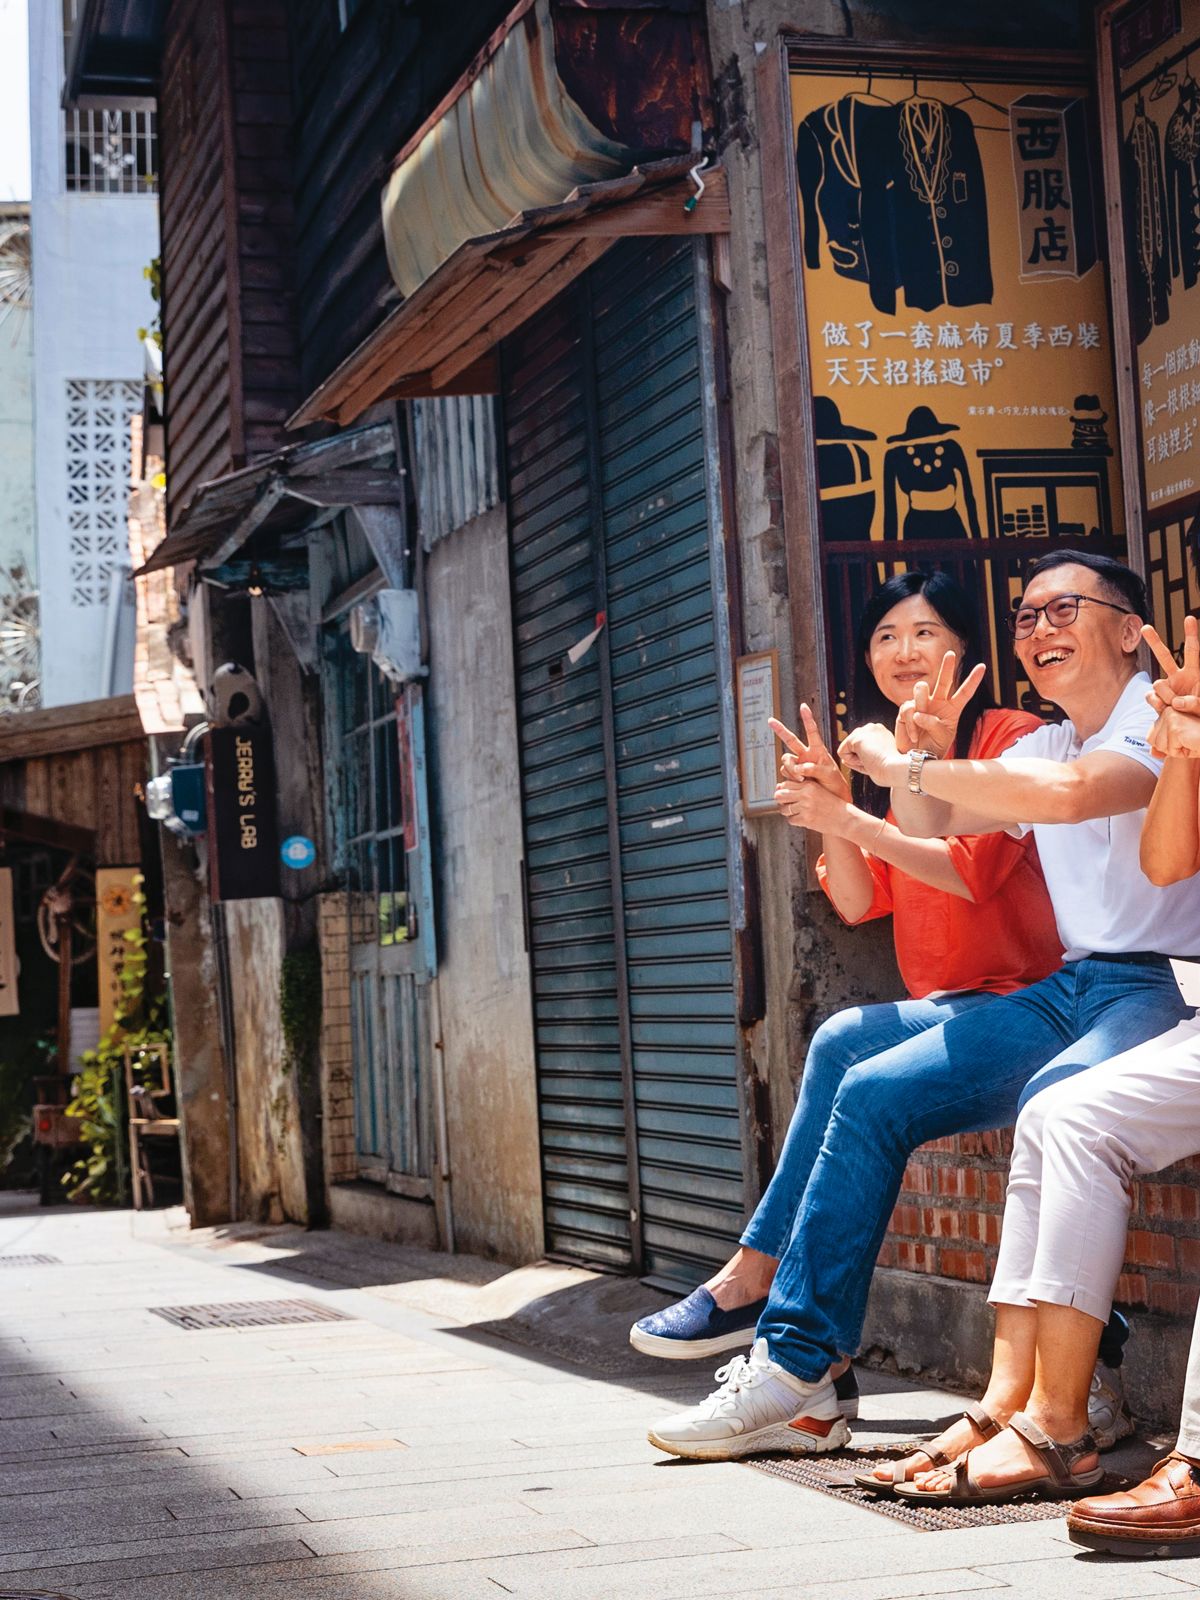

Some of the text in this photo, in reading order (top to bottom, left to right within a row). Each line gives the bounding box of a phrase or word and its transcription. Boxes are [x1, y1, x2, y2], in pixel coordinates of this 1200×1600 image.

[1016, 117, 1070, 264] 西服店
[820, 320, 1101, 351] 做了一套麻布夏季西裝
[235, 735, 258, 850] JERRY'S LAB
